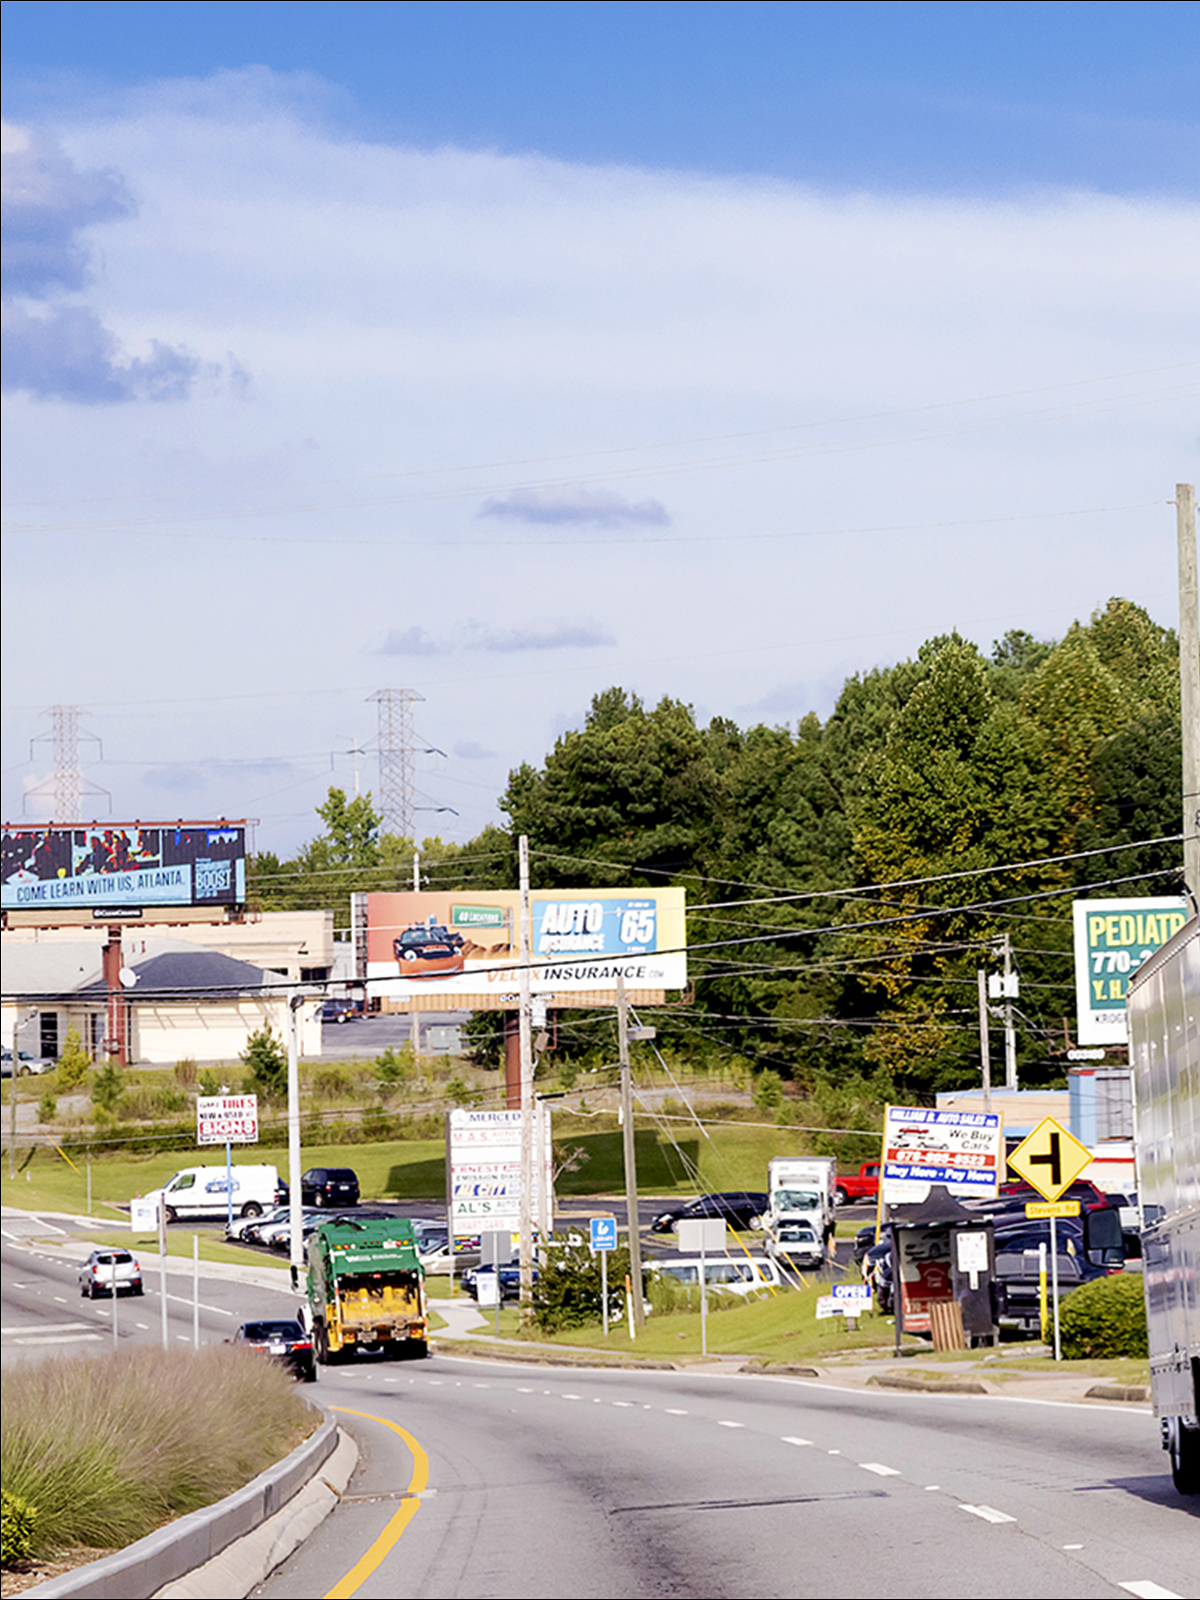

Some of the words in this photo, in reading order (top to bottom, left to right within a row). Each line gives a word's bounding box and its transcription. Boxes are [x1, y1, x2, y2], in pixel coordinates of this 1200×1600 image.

[196, 869, 232, 889] BOOST
[16, 885, 47, 903] COME
[50, 881, 90, 900] LEARN
[92, 879, 115, 895] WITH
[540, 903, 603, 934] AUTO
[539, 934, 605, 953] INSURANCE
[486, 967, 541, 983] VELX
[949, 1129, 968, 1139] We
[970, 1130, 994, 1142] Buy
[961, 1140, 990, 1151] Cars
[886, 1166, 908, 1178] Buy
[457, 1201, 492, 1214] AL'S
[835, 1285, 867, 1298] OPEN
